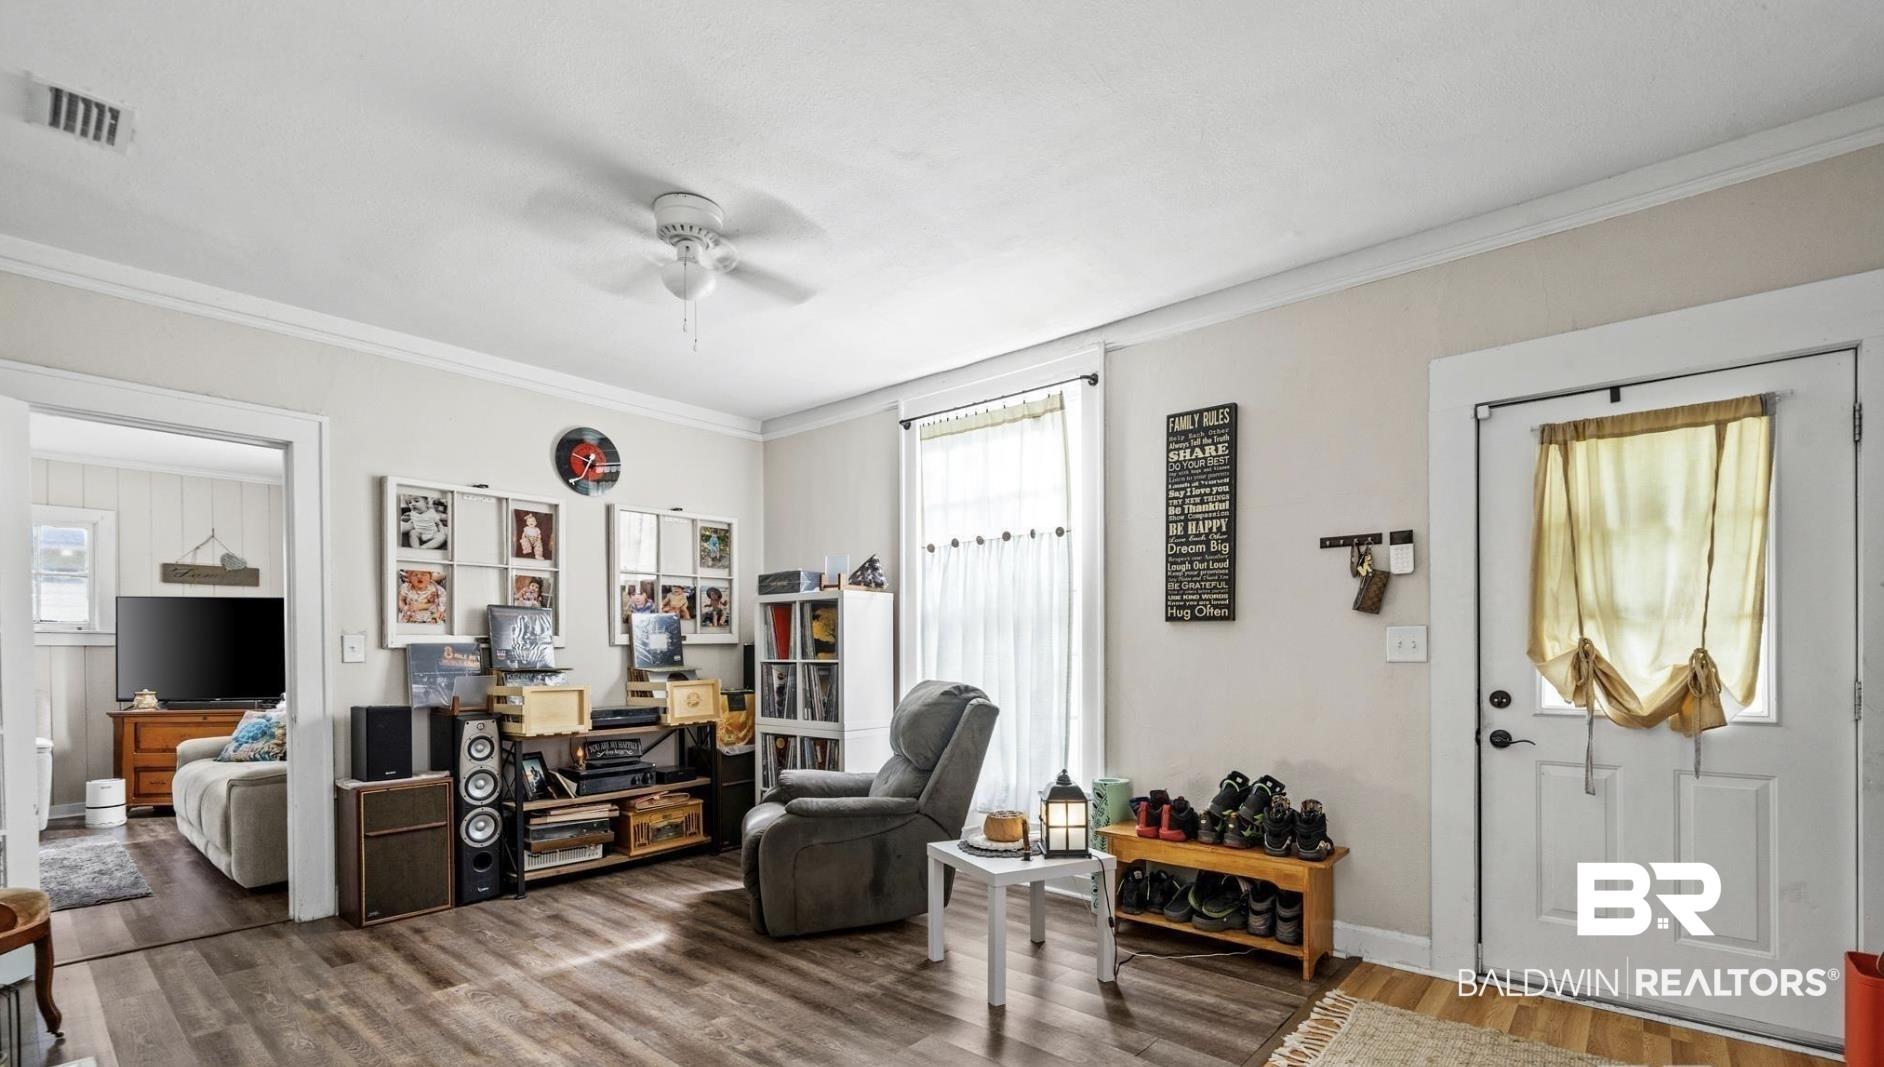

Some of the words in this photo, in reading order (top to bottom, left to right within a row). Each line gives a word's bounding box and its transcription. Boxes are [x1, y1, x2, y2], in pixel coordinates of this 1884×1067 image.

[1169, 413, 1199, 432] FAMILY
[1203, 408, 1229, 427] RULES
[1191, 438, 1200, 446] Tell
[1214, 434, 1229, 442] Truth
[1168, 444, 1228, 461] SHARE
[1182, 460, 1205, 469] YOUR
[1207, 456, 1229, 466] BEST
[1212, 486, 1229, 494] you
[1203, 494, 1229, 502] THINGS
[1168, 506, 1181, 515] Be
[1183, 501, 1229, 513] Thankful
[1188, 511, 1229, 519] Compassion
[1169, 523, 1184, 535] BE
[1188, 519, 1228, 534] HAPPY
[1168, 544, 1205, 554] Dream
[1211, 540, 1229, 554] Big
[1168, 562, 1190, 571] Laugh
[1193, 561, 1207, 569] Out
[1210, 559, 1228, 568] Loud
[1168, 607, 1191, 620] Hug
[1195, 605, 1228, 616] Often
